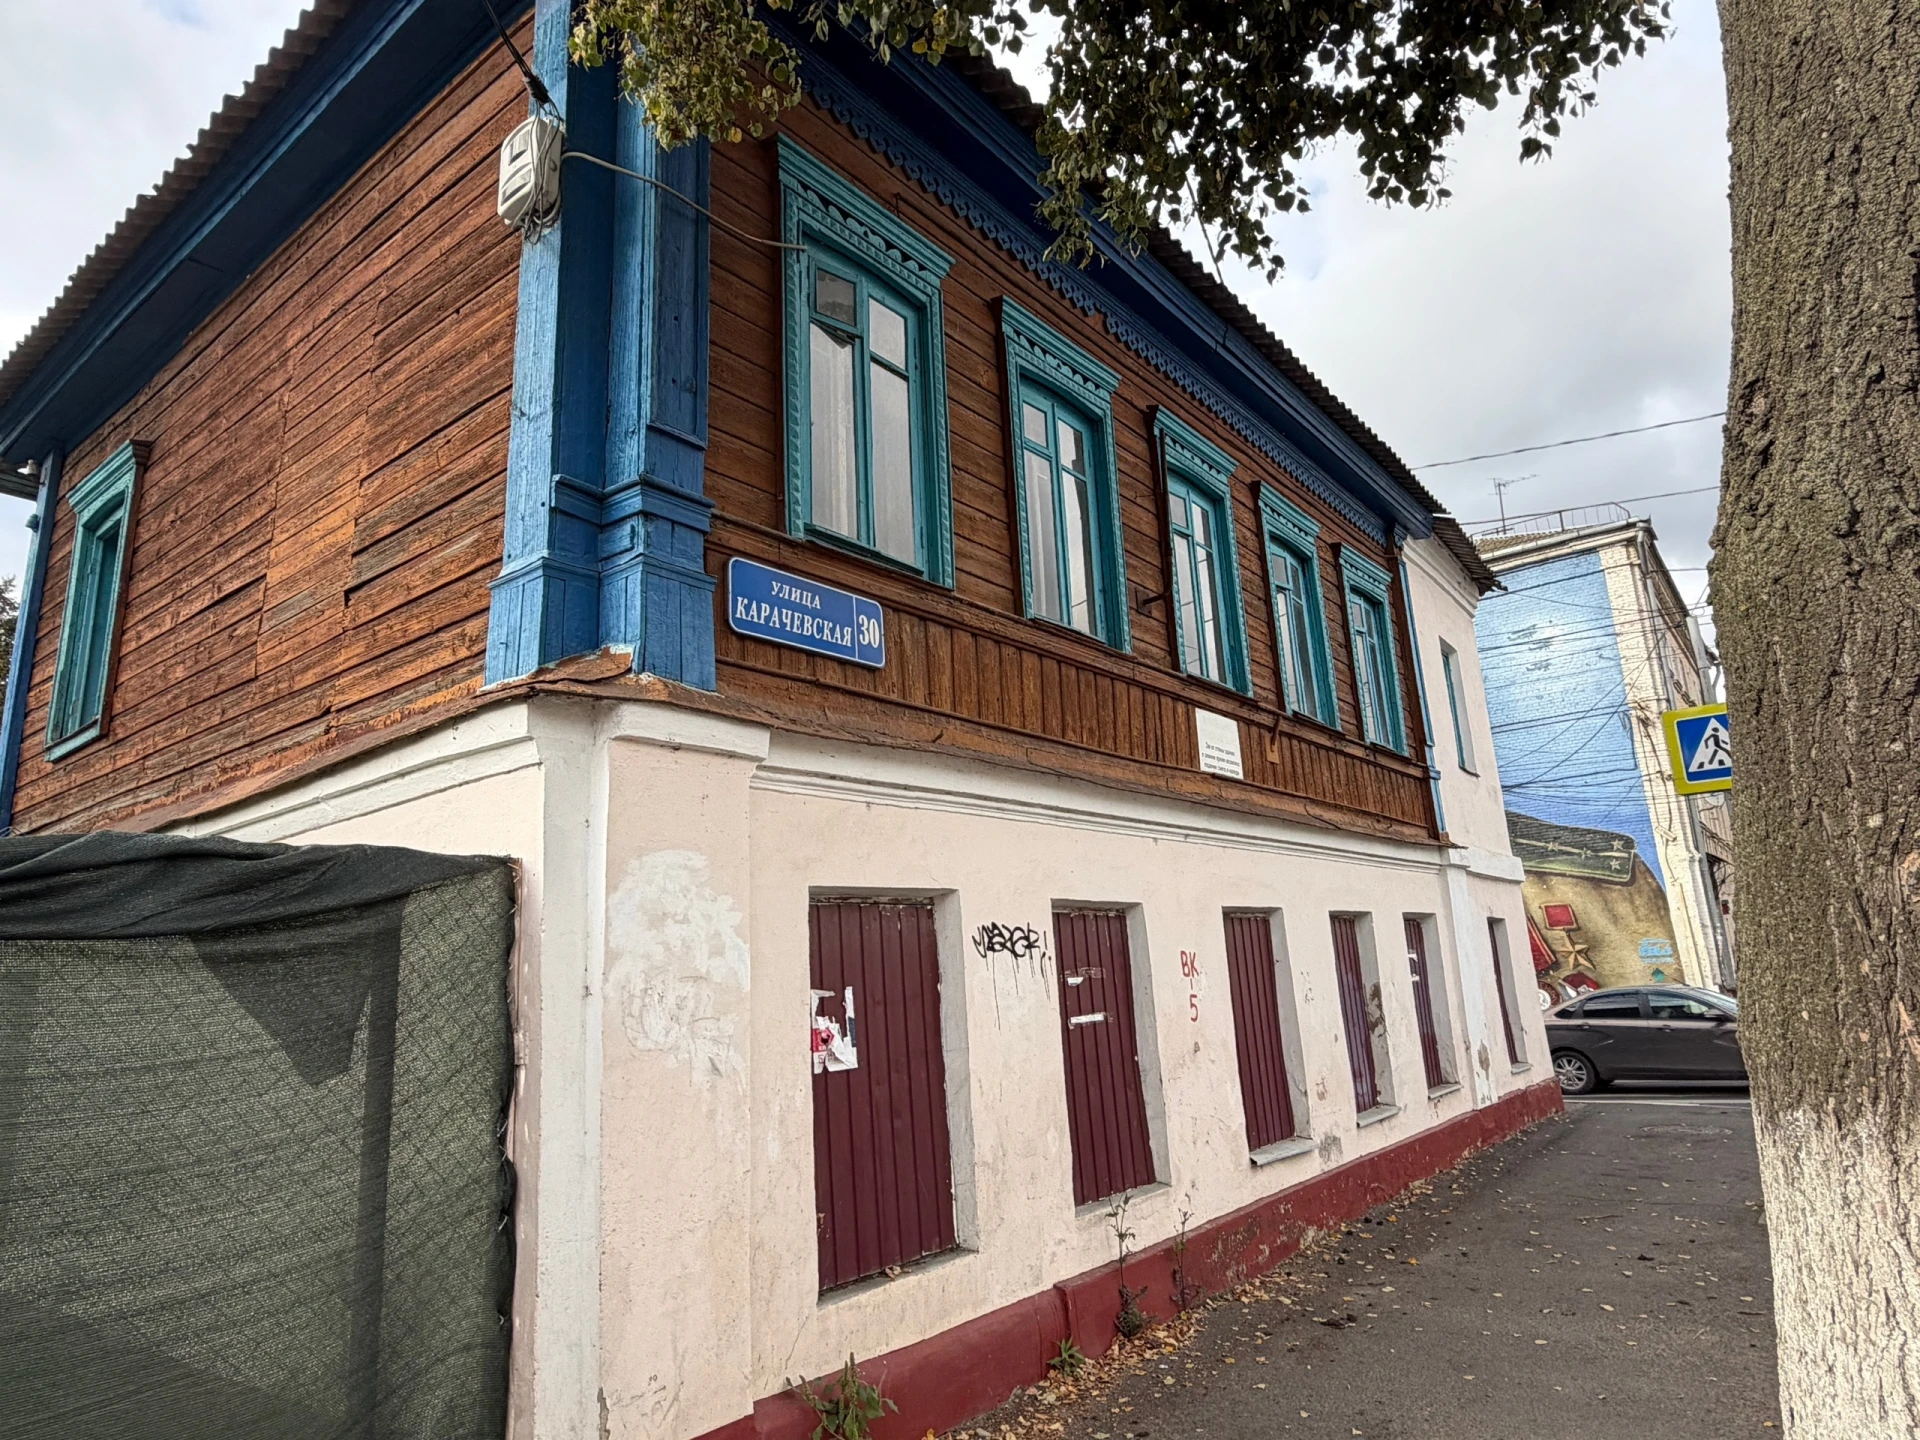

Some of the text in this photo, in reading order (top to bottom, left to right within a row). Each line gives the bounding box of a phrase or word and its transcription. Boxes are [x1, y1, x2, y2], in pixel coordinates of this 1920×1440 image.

[771, 581, 821, 609] УЛИЦА
[735, 596, 852, 647] КАРАЧЕВСКАЯ
[858, 614, 880, 648] 30
[1189, 994, 1199, 1022] 5
